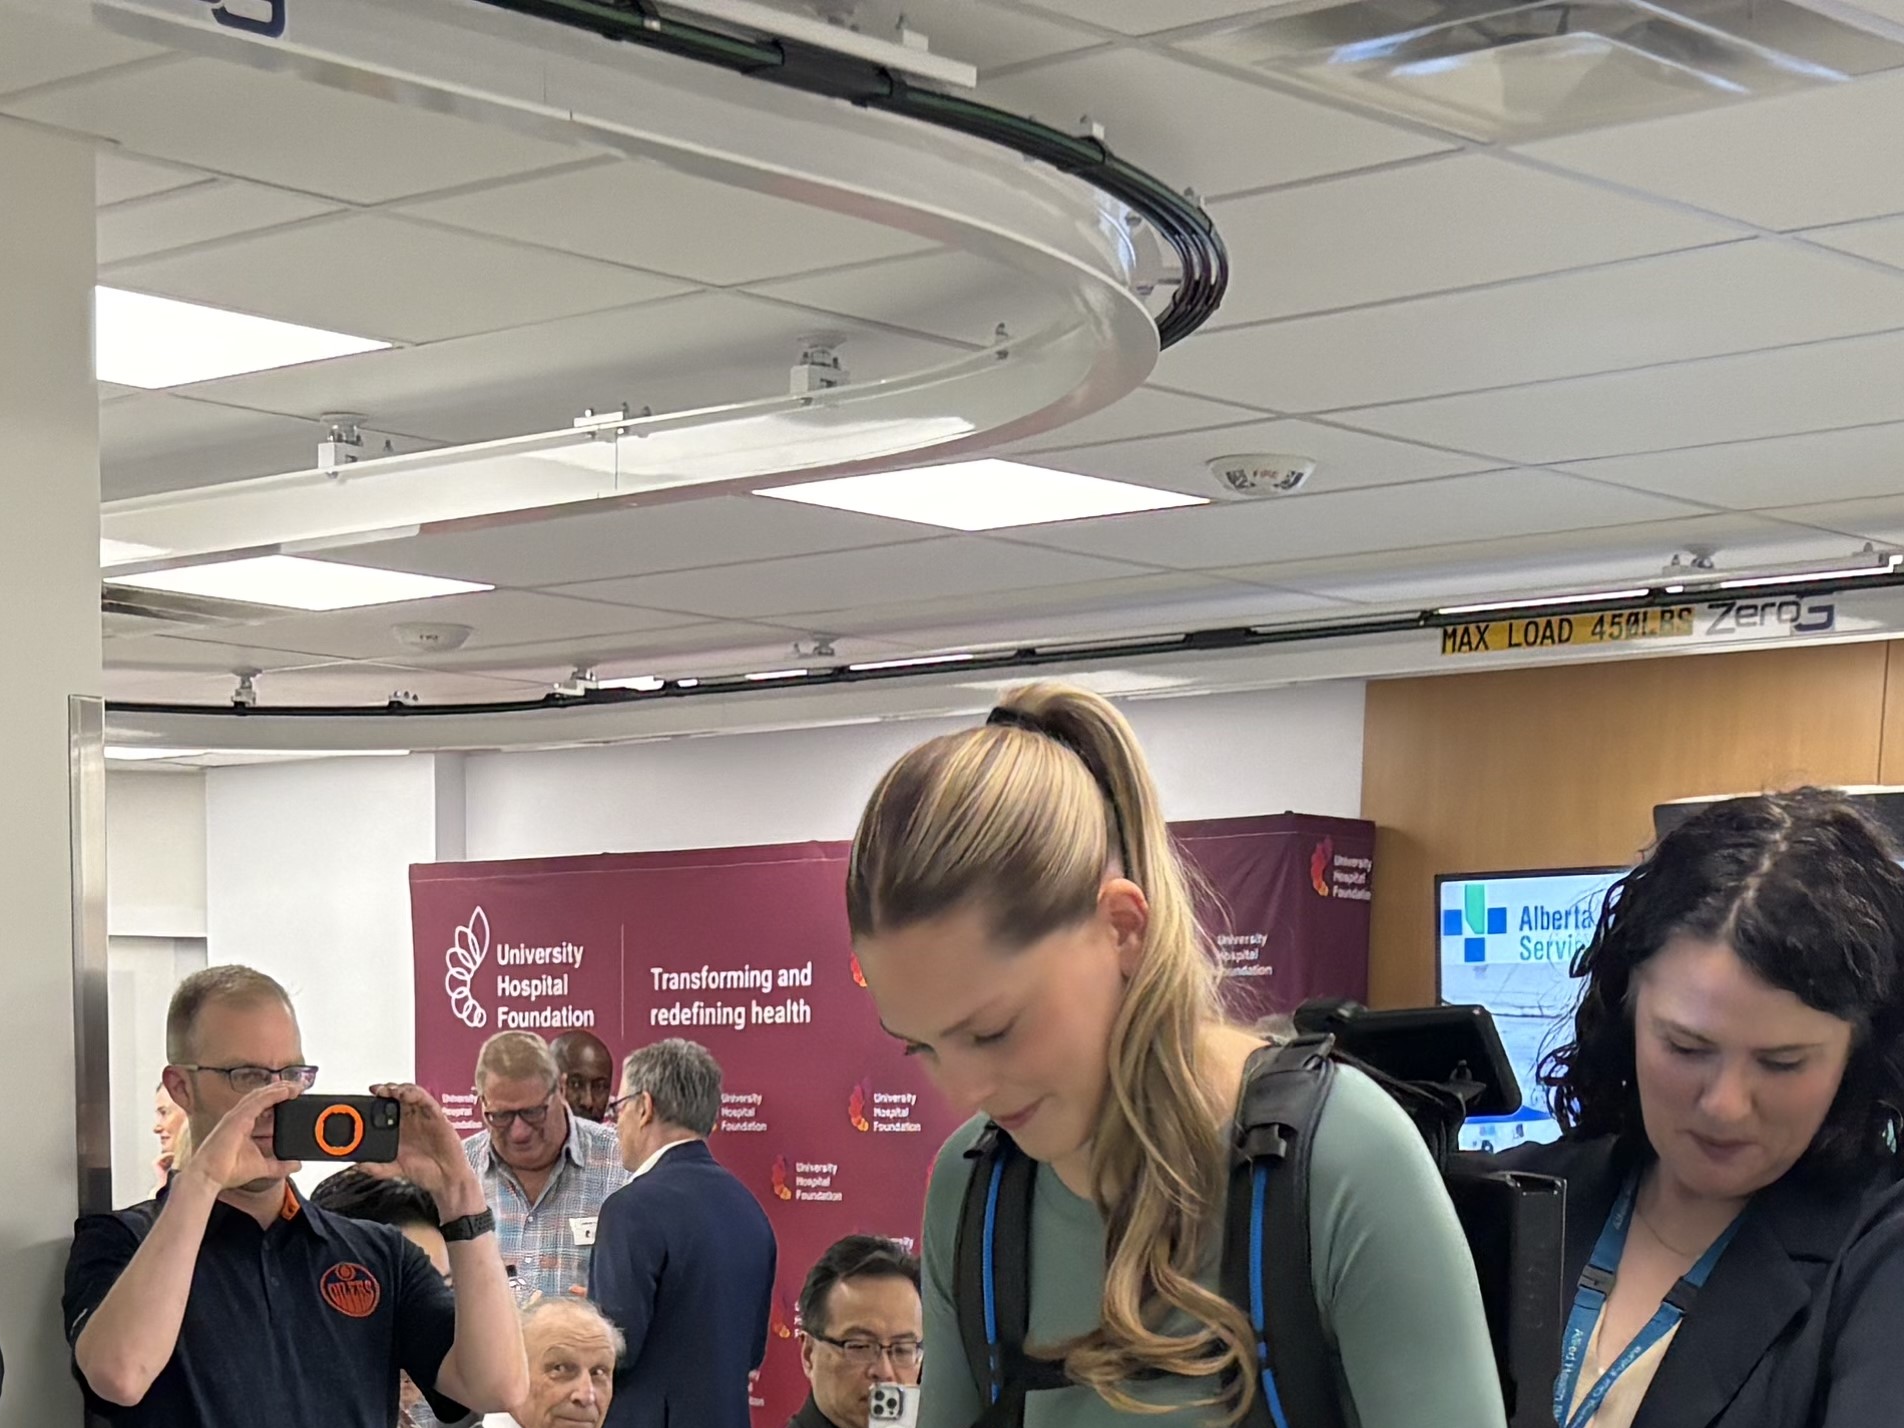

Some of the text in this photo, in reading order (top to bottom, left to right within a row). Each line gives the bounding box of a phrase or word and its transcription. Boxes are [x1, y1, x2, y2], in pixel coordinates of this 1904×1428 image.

[1442, 623, 1489, 653] MAX
[1508, 617, 1573, 646] LOAD
[1519, 906, 1592, 931] Alberta
[497, 942, 584, 968] University
[497, 974, 568, 1001] Hospital
[650, 961, 813, 994] Transforming and
[497, 1006, 595, 1029] Foundation
[650, 999, 811, 1031] redefining health
[873, 1093, 917, 1106] University
[873, 1107, 910, 1121] Hospital
[873, 1122, 922, 1133] Foundation
